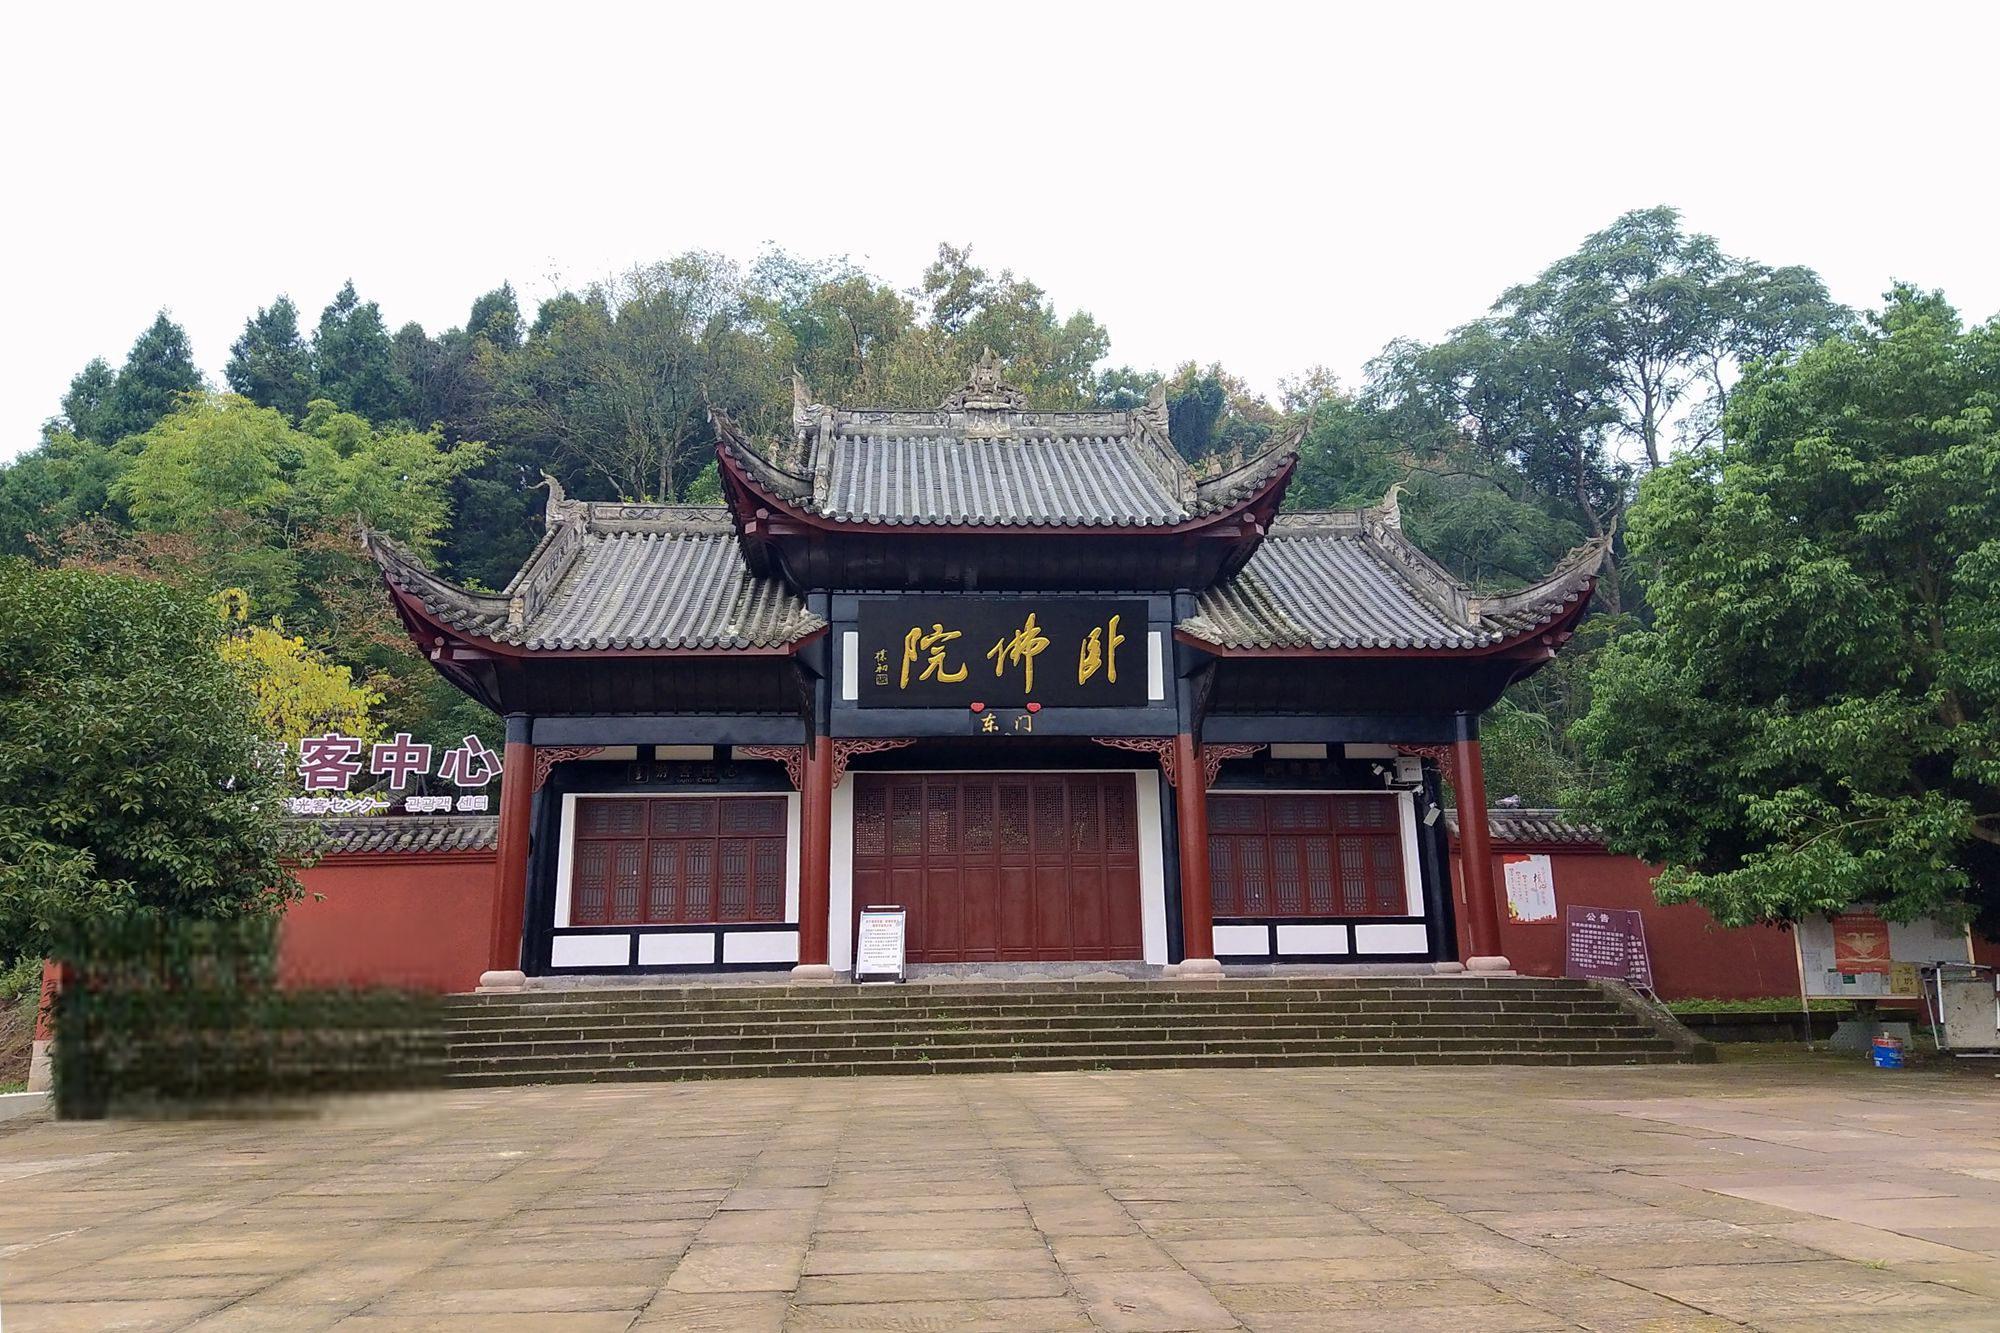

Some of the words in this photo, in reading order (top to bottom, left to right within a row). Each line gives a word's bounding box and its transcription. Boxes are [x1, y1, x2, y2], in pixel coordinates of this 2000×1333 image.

[900, 612, 1126, 694] 卧佛院
[981, 712, 1033, 733] 东门
[256, 733, 504, 790] 客中心
[1586, 911, 1610, 923] 公告
